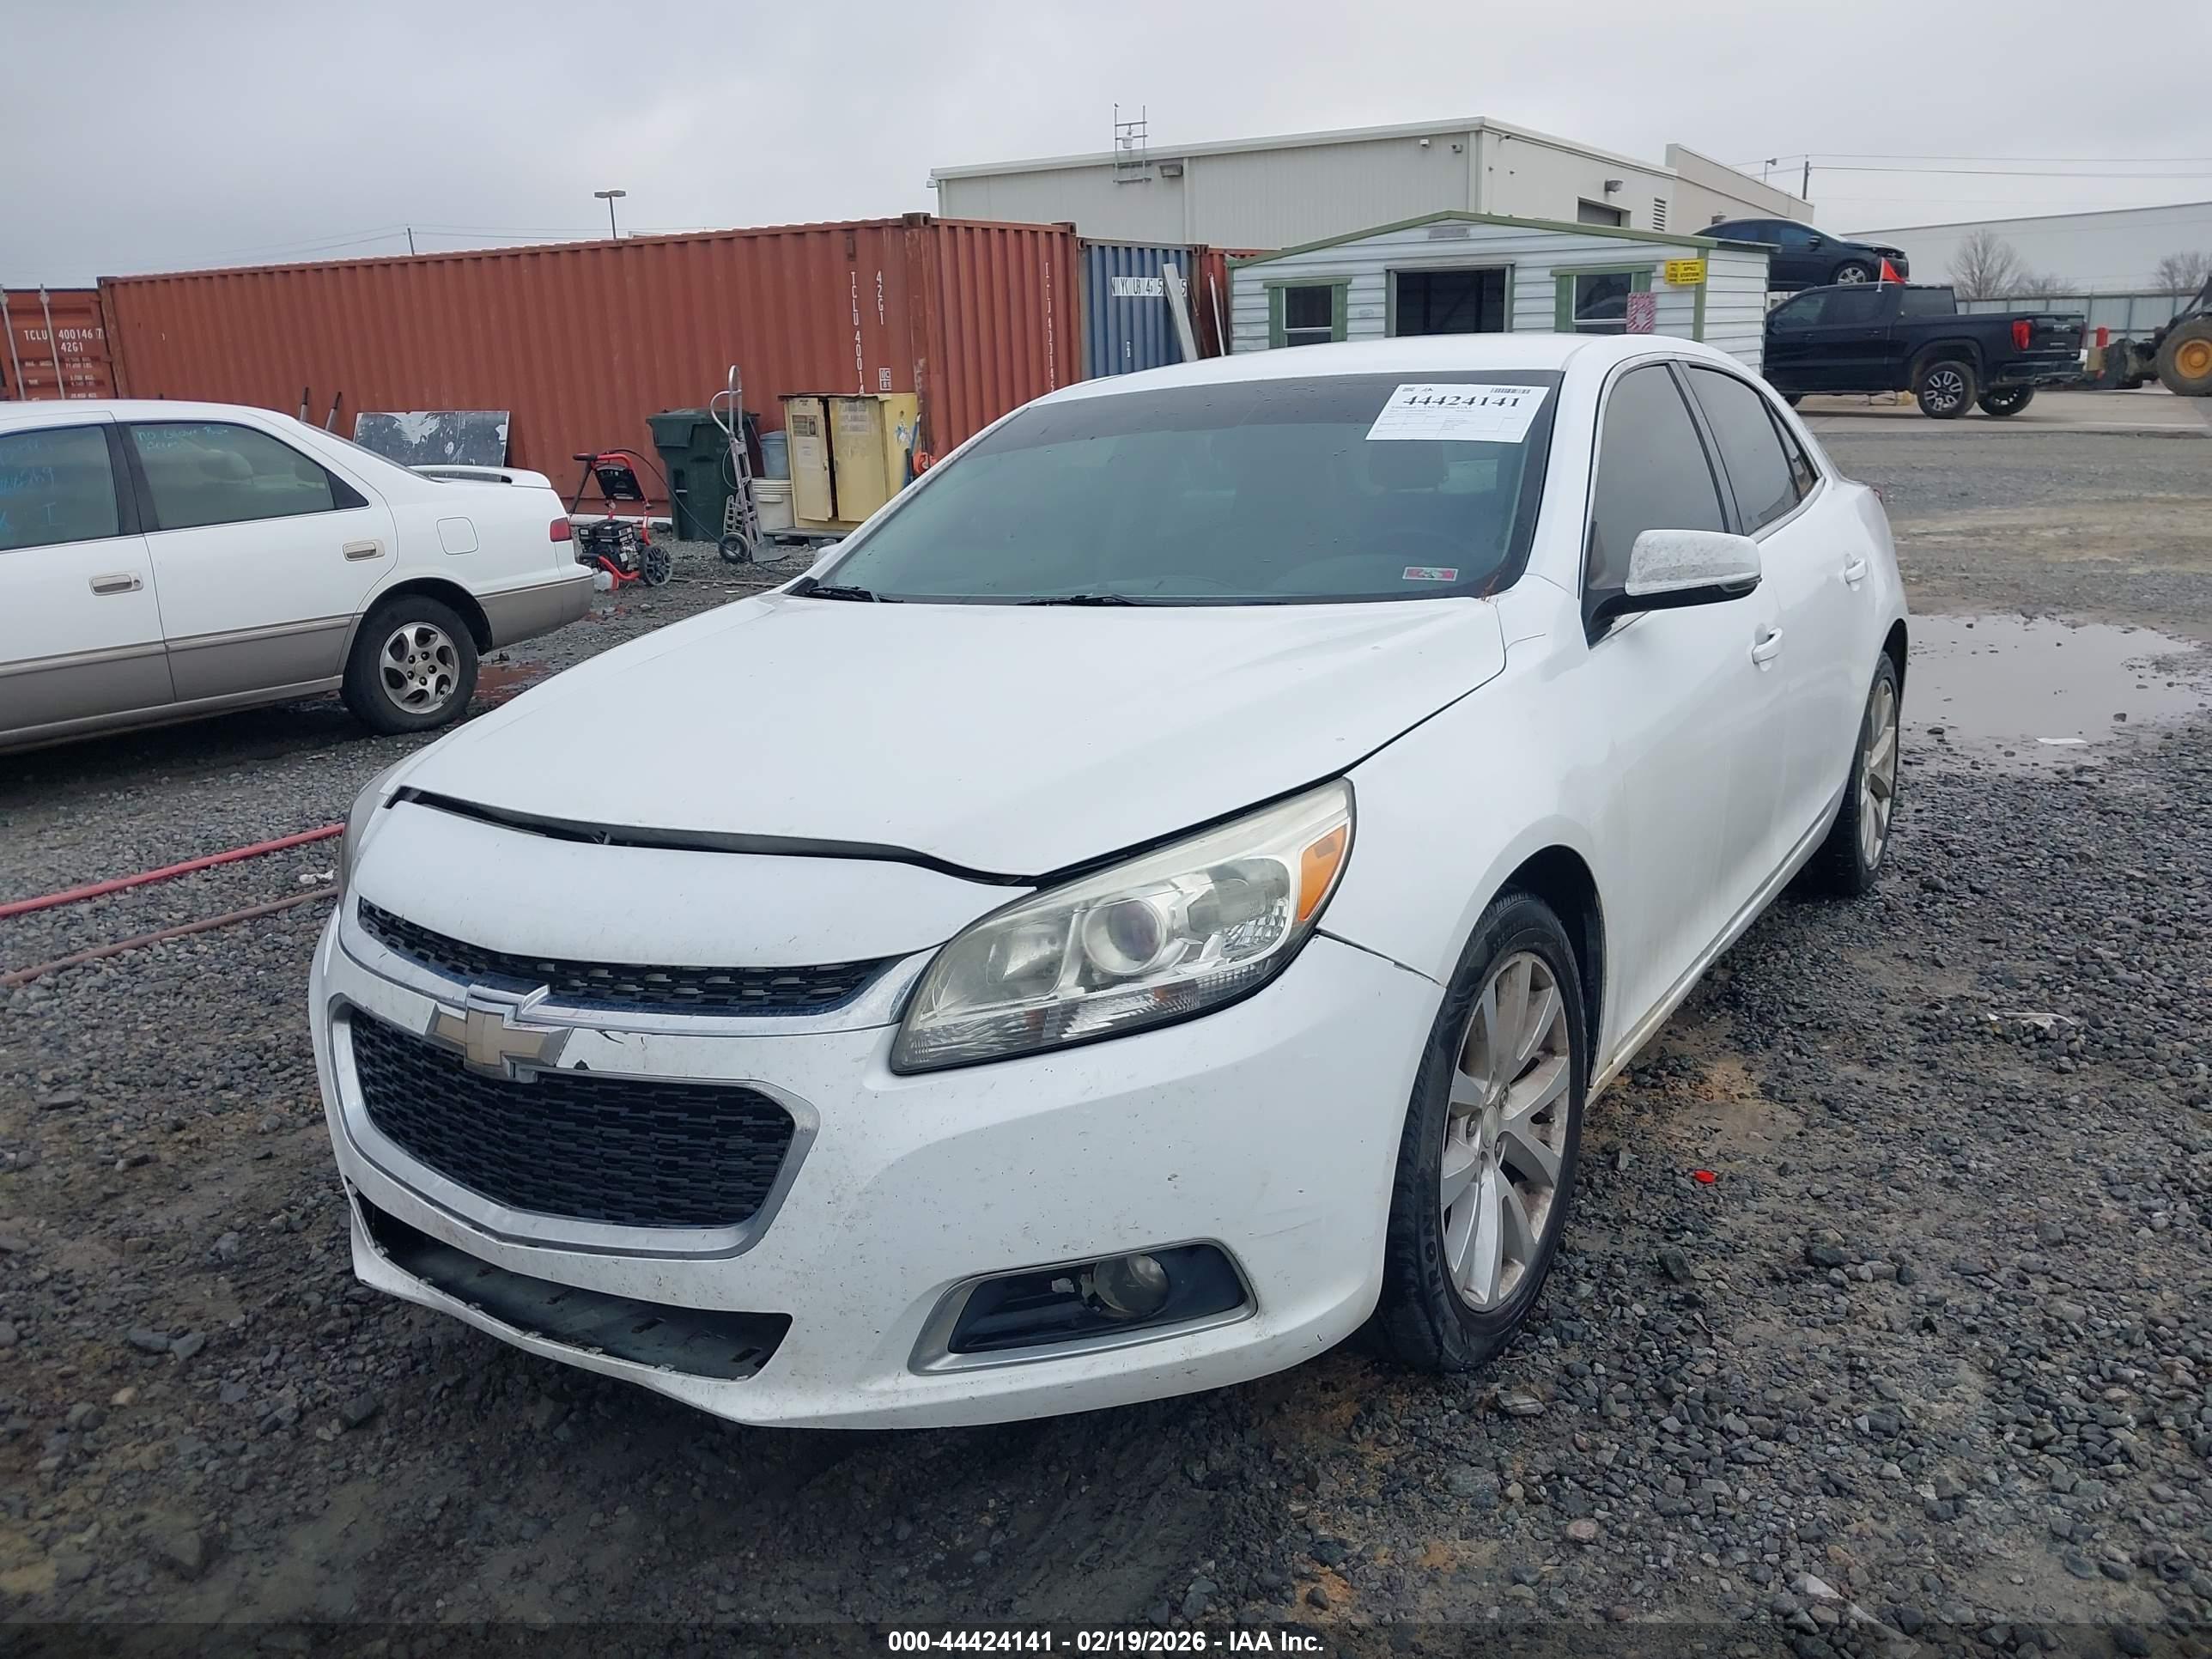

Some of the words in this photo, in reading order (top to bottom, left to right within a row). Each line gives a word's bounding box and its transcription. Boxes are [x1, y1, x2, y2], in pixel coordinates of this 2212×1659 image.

[850, 271, 860, 326] TCLU
[876, 270, 884, 325] 42G1
[24, 329, 48, 341] TCLU
[58, 329, 94, 340] 400146
[60, 342, 83, 353] 42G1
[1403, 395, 1520, 407] 44424141
